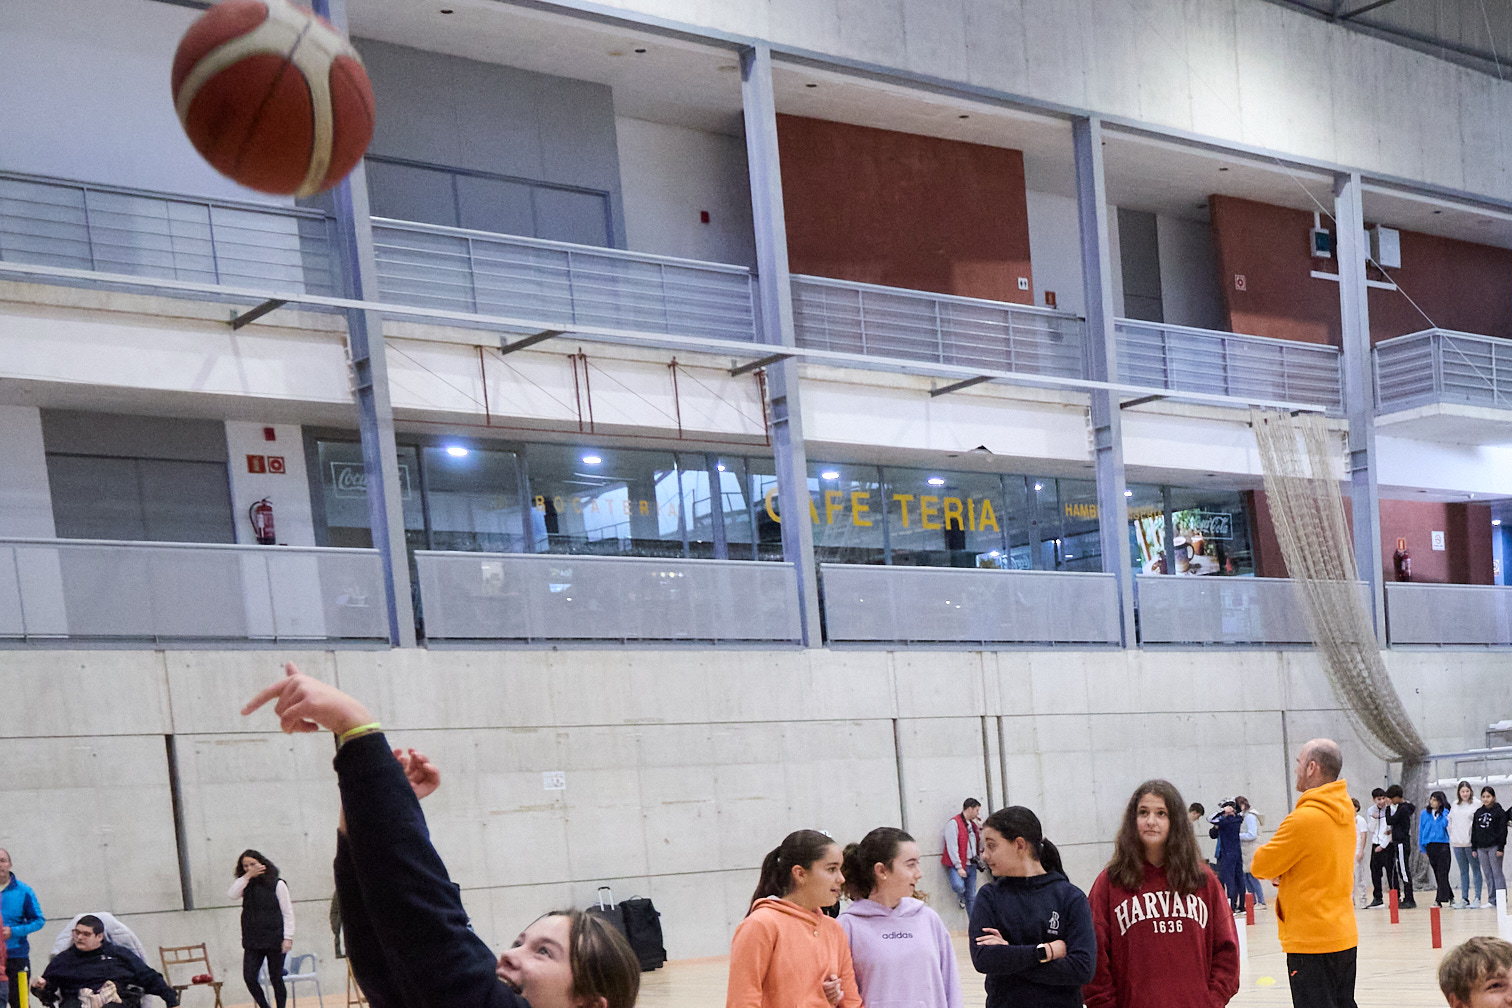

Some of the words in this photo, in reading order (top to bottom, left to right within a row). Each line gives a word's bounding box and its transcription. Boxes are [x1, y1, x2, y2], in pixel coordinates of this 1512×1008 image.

[535, 495, 678, 517] BOCATERIA
[893, 493, 1000, 532] TERIA
[1114, 890, 1209, 936] HARVARD
[882, 931, 913, 940] adidas
[1153, 919, 1183, 934] 1636
